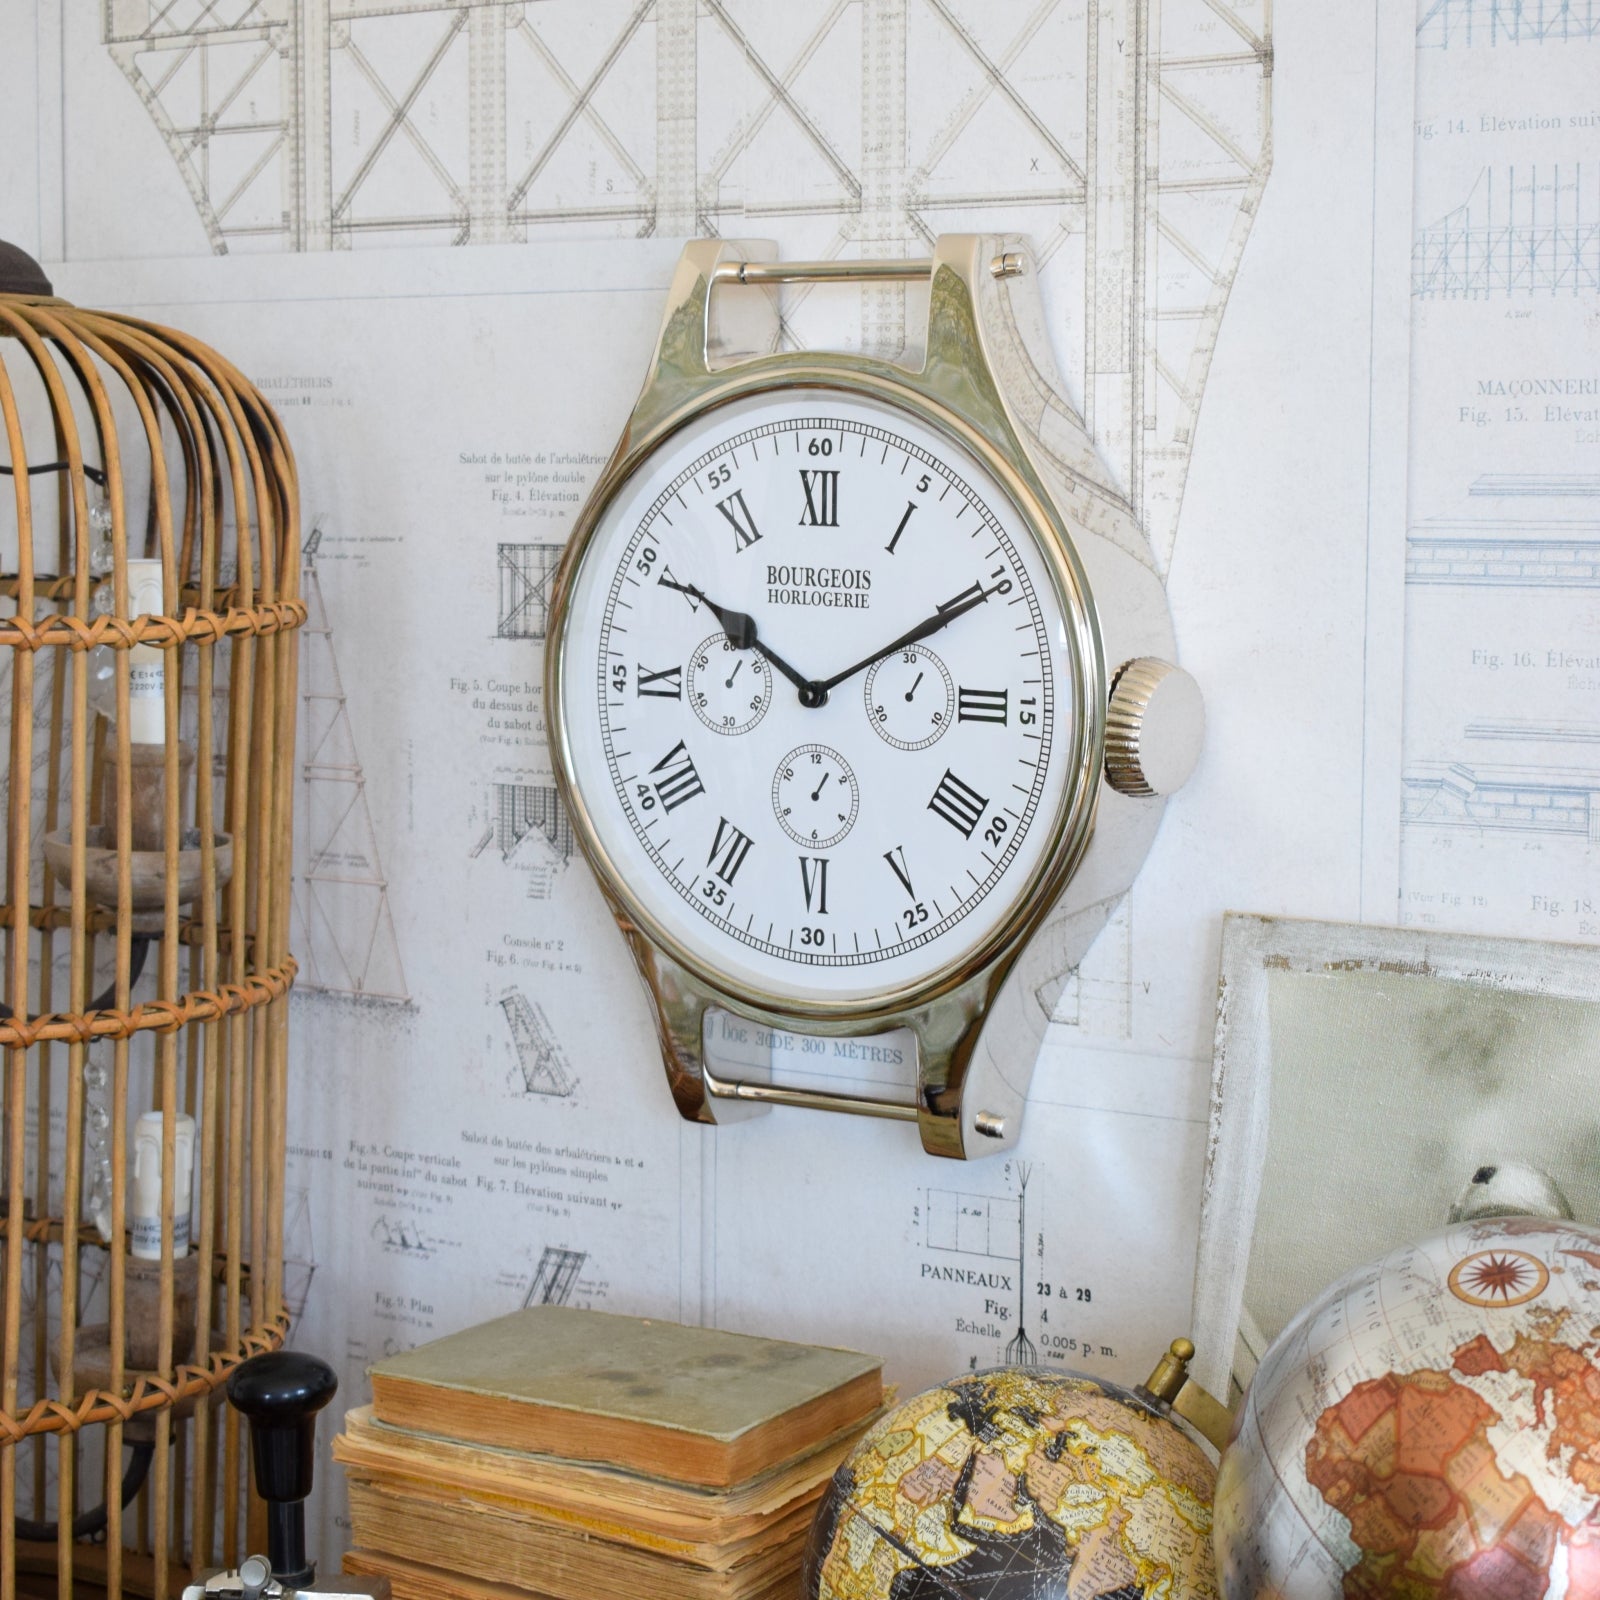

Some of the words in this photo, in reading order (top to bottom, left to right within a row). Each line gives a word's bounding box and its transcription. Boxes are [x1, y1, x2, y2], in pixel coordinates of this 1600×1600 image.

[1447, 119, 1471, 134] 14.
[1479, 112, 1561, 133] Élévation
[1459, 406, 1493, 428] Fig.
[1504, 406, 1529, 423] 15.
[807, 437, 834, 457] 60
[458, 452, 487, 465] Sabot
[490, 453, 502, 465] de
[535, 454, 547, 465] de
[485, 472, 500, 483] sur
[503, 472, 513, 484] le
[552, 472, 586, 484] double
[707, 463, 732, 490] 55
[915, 473, 933, 493] 5
[491, 489, 513, 504] Fig.
[529, 487, 580, 502] Élévation
[798, 469, 841, 527] XII
[714, 488, 764, 554] XI
[884, 500, 919, 556] I
[636, 547, 657, 577] 50
[656, 563, 706, 614] X
[766, 565, 871, 590] BOURGEOIS
[990, 564, 1013, 596] 10
[767, 588, 870, 609] HORLOGERIE
[723, 640, 737, 652] 60
[697, 655, 709, 672] 50
[750, 660, 762, 674] 10
[902, 652, 917, 664] 30
[1471, 649, 1505, 671] Fig.
[1512, 651, 1537, 668] 16.
[450, 678, 471, 695] Fig.
[487, 679, 521, 697] Coupe
[524, 682, 544, 695] hor
[612, 664, 628, 693] 45
[637, 662, 682, 702] IX
[472, 697, 487, 710] du
[489, 700, 524, 713] dessus
[526, 701, 539, 713] de
[697, 692, 708, 708] 40
[749, 695, 763, 712] 20
[957, 685, 1009, 728] III
[1019, 696, 1037, 726] 15
[487, 716, 501, 729] du
[504, 719, 533, 732] sabot
[722, 715, 736, 727] 30
[874, 705, 888, 723] 20
[930, 711, 943, 727] 10
[810, 753, 822, 765] 12
[647, 738, 707, 816] VIII
[783, 768, 794, 782] 10
[838, 775, 848, 785] 2
[636, 783, 656, 811] 40
[926, 767, 990, 841] IIII
[782, 807, 792, 817] 8
[837, 813, 847, 822] 4
[811, 828, 819, 840] 6
[984, 816, 1008, 848] 20
[706, 815, 756, 888] VII
[882, 845, 916, 902] V
[702, 880, 728, 907] 35
[798, 856, 830, 914] VI
[902, 902, 929, 929] 25
[1531, 894, 1565, 917] Fig.
[1573, 899, 1598, 915] 18.
[503, 934, 542, 949] Console
[557, 940, 565, 951] 2
[800, 926, 826, 947] 30
[486, 950, 508, 968] Fig.
[509, 953, 520, 966] 6.
[801, 1038, 827, 1056] 300
[833, 1039, 905, 1066] MÈTRES
[461, 1131, 488, 1145] Sabot
[491, 1136, 504, 1147] de
[384, 1146, 416, 1164] Coupe
[418, 1153, 462, 1169] verticale
[343, 1158, 356, 1169] de
[357, 1160, 368, 1171] la
[440, 1173, 468, 1188] sabot
[493, 1156, 511, 1167] sur
[512, 1155, 527, 1170] les
[569, 1168, 609, 1184] simples
[476, 1175, 496, 1193] Fig.
[513, 1178, 564, 1202] Élévation
[567, 1194, 608, 1209] suivant
[920, 1262, 1013, 1292] PANNEAUX
[1036, 1282, 1052, 1297] 23
[1058, 1286, 1068, 1299] à
[1076, 1287, 1092, 1303] 29
[984, 1298, 1012, 1321] Fig.
[1040, 1308, 1049, 1324] 4
[955, 1317, 1002, 1339] Échelle
[1040, 1332, 1077, 1351] 0.005
[1081, 1342, 1096, 1358] p.
[1100, 1345, 1118, 1358] m.
